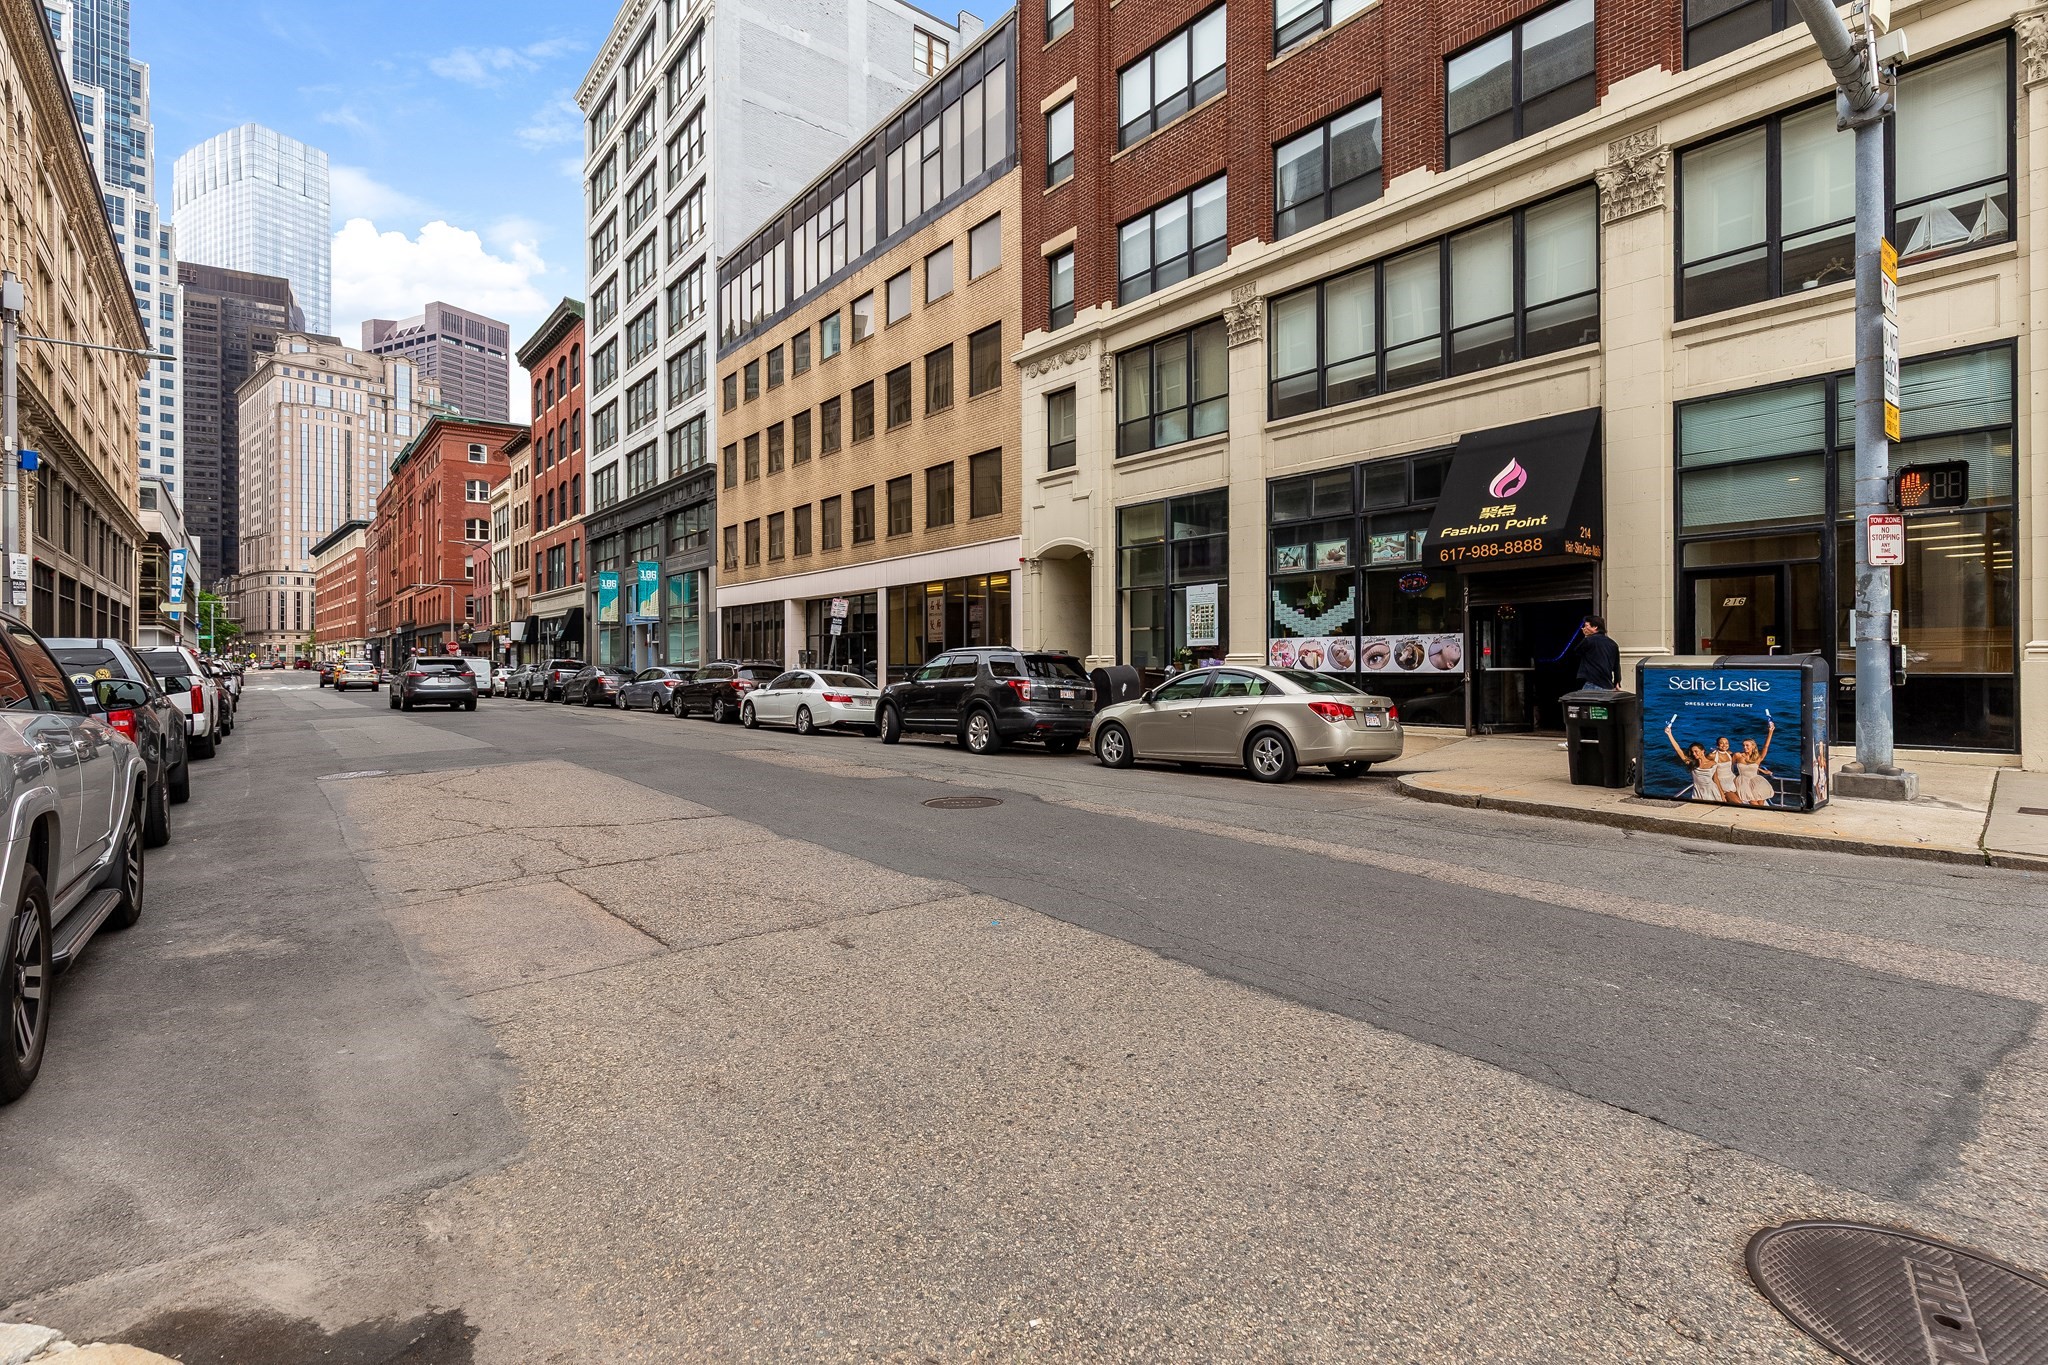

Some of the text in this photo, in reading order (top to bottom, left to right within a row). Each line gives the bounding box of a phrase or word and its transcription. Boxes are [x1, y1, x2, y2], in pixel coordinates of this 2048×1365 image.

[1441, 515, 1548, 538] Fashion Point
[1580, 526, 1591, 539] 214
[1440, 538, 1543, 561] 617-988-8888
[171, 552, 184, 597] PARK
[640, 570, 657, 580] 186
[601, 579, 617, 588] 186
[1399, 577, 1427, 589] OPEN
[1724, 598, 1745, 606] 216
[1669, 676, 1771, 692] Selfie Leslie
